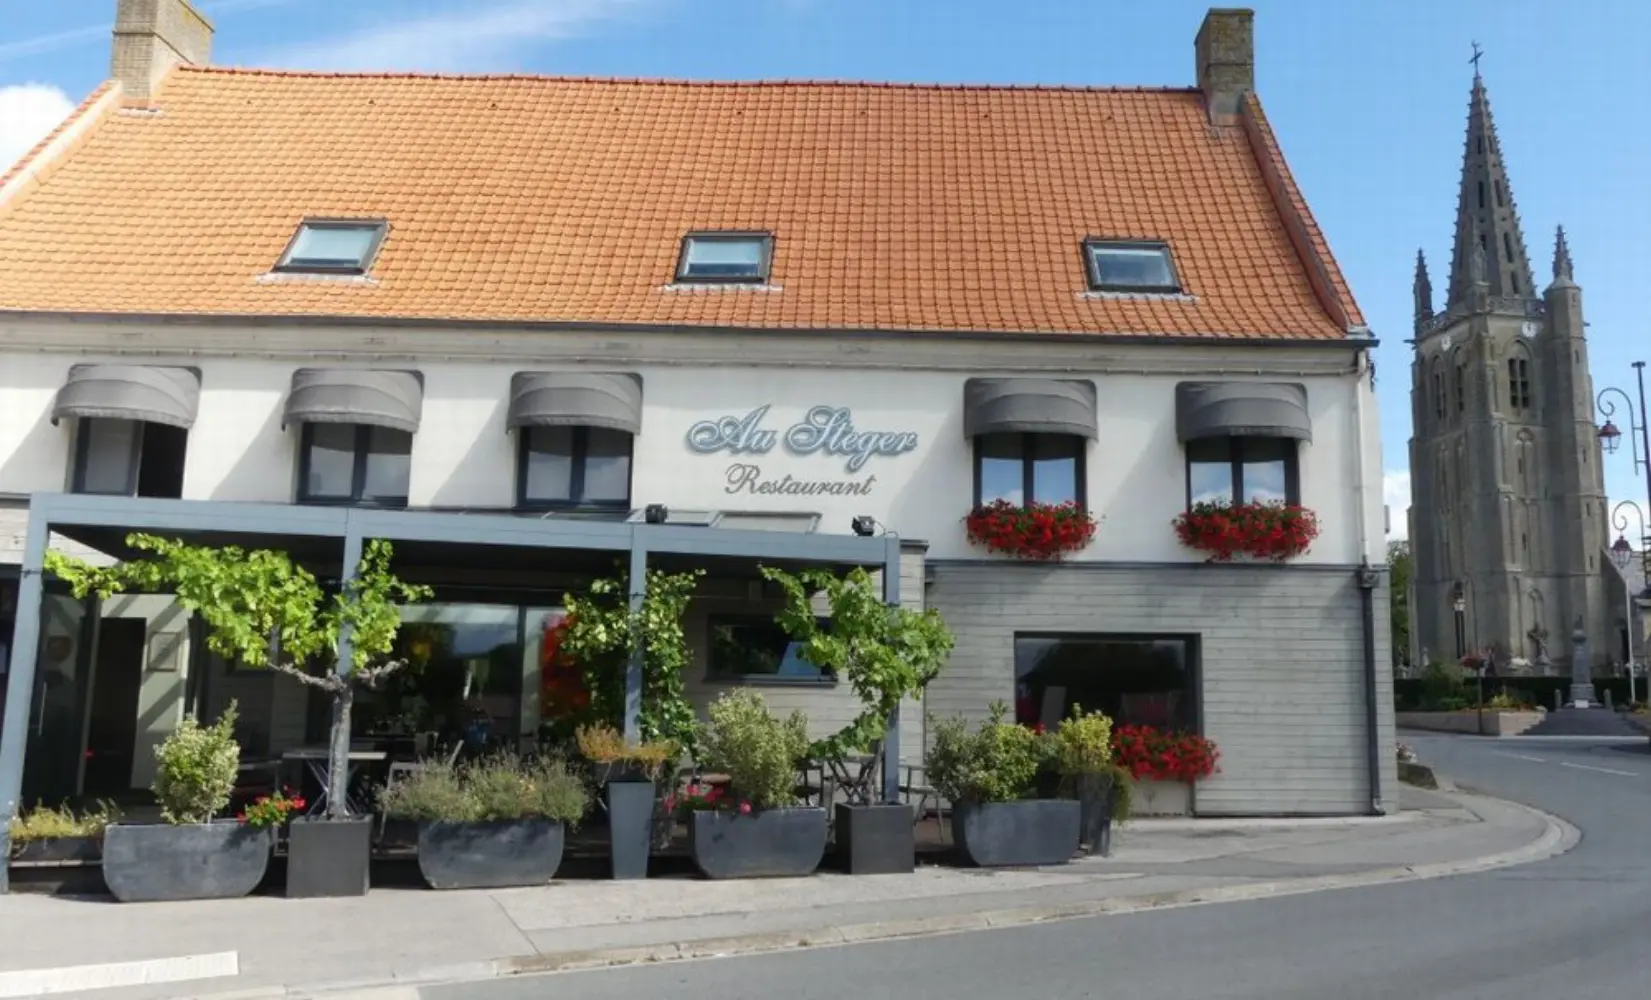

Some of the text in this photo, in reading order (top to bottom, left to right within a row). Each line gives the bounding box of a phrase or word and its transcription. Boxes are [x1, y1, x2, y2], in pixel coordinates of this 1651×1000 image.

[686, 404, 918, 473] Au Steger
[725, 463, 876, 495] Restaurant
